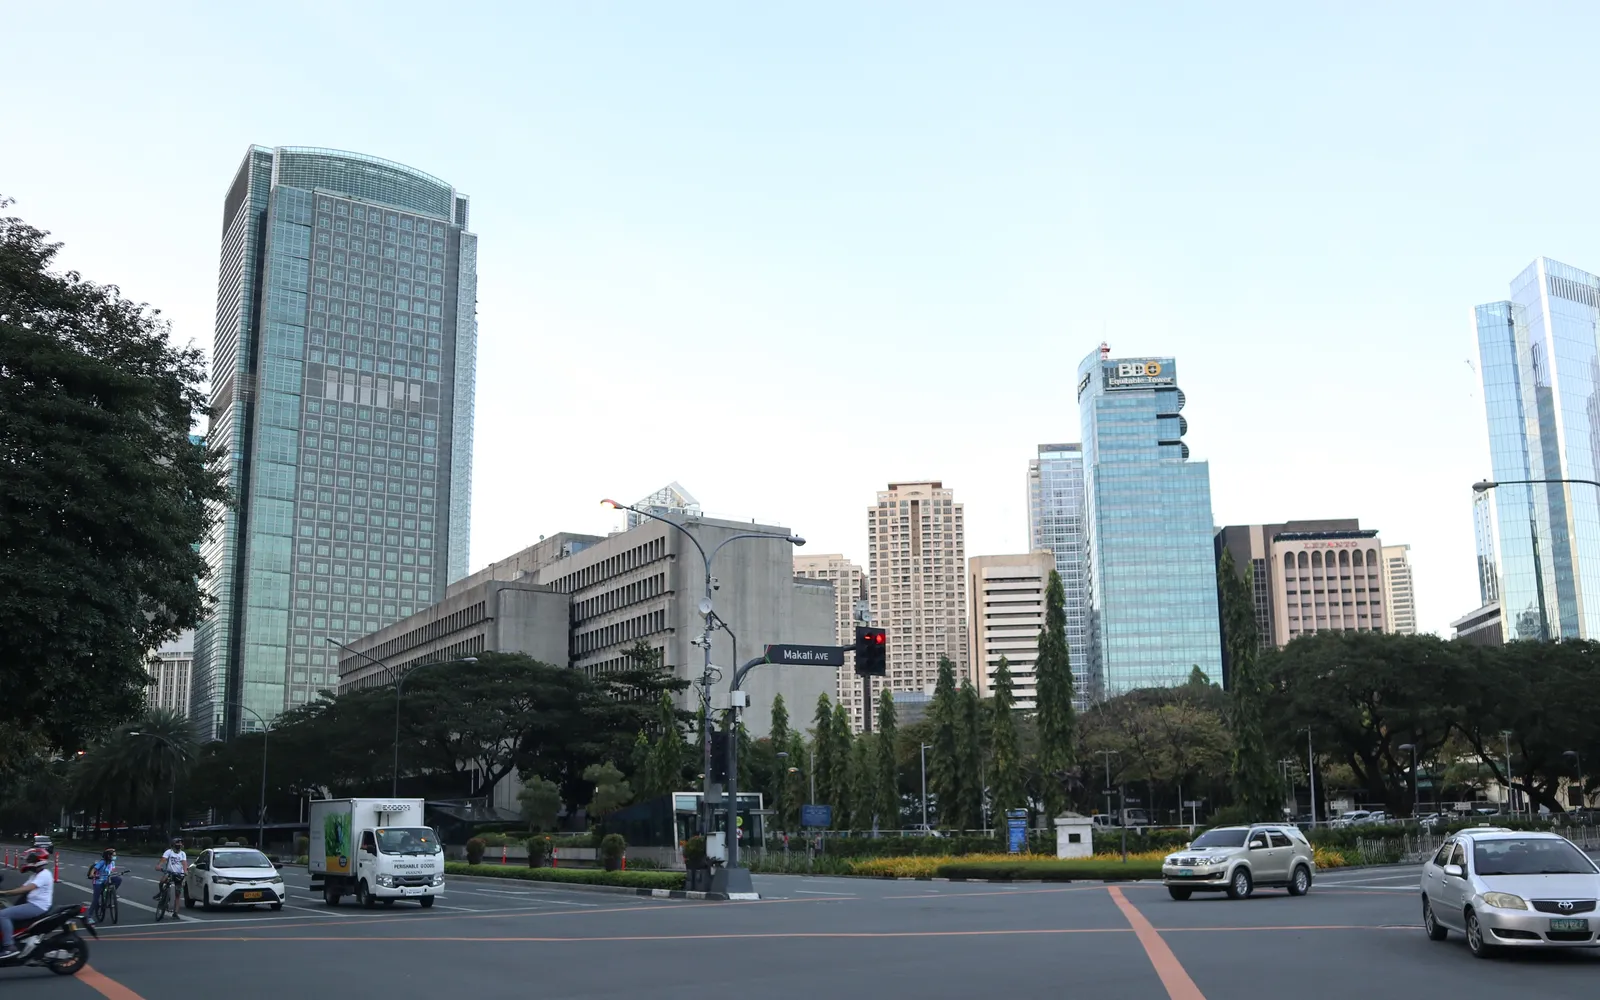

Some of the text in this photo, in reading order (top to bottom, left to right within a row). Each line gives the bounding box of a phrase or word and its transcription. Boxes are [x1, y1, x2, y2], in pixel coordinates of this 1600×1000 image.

[1118, 361, 1161, 377] BDO
[1108, 375, 1172, 386] Equitable Tower
[1303, 541, 1358, 549] LEPANTO
[783, 649, 829, 661] Makati AVE
